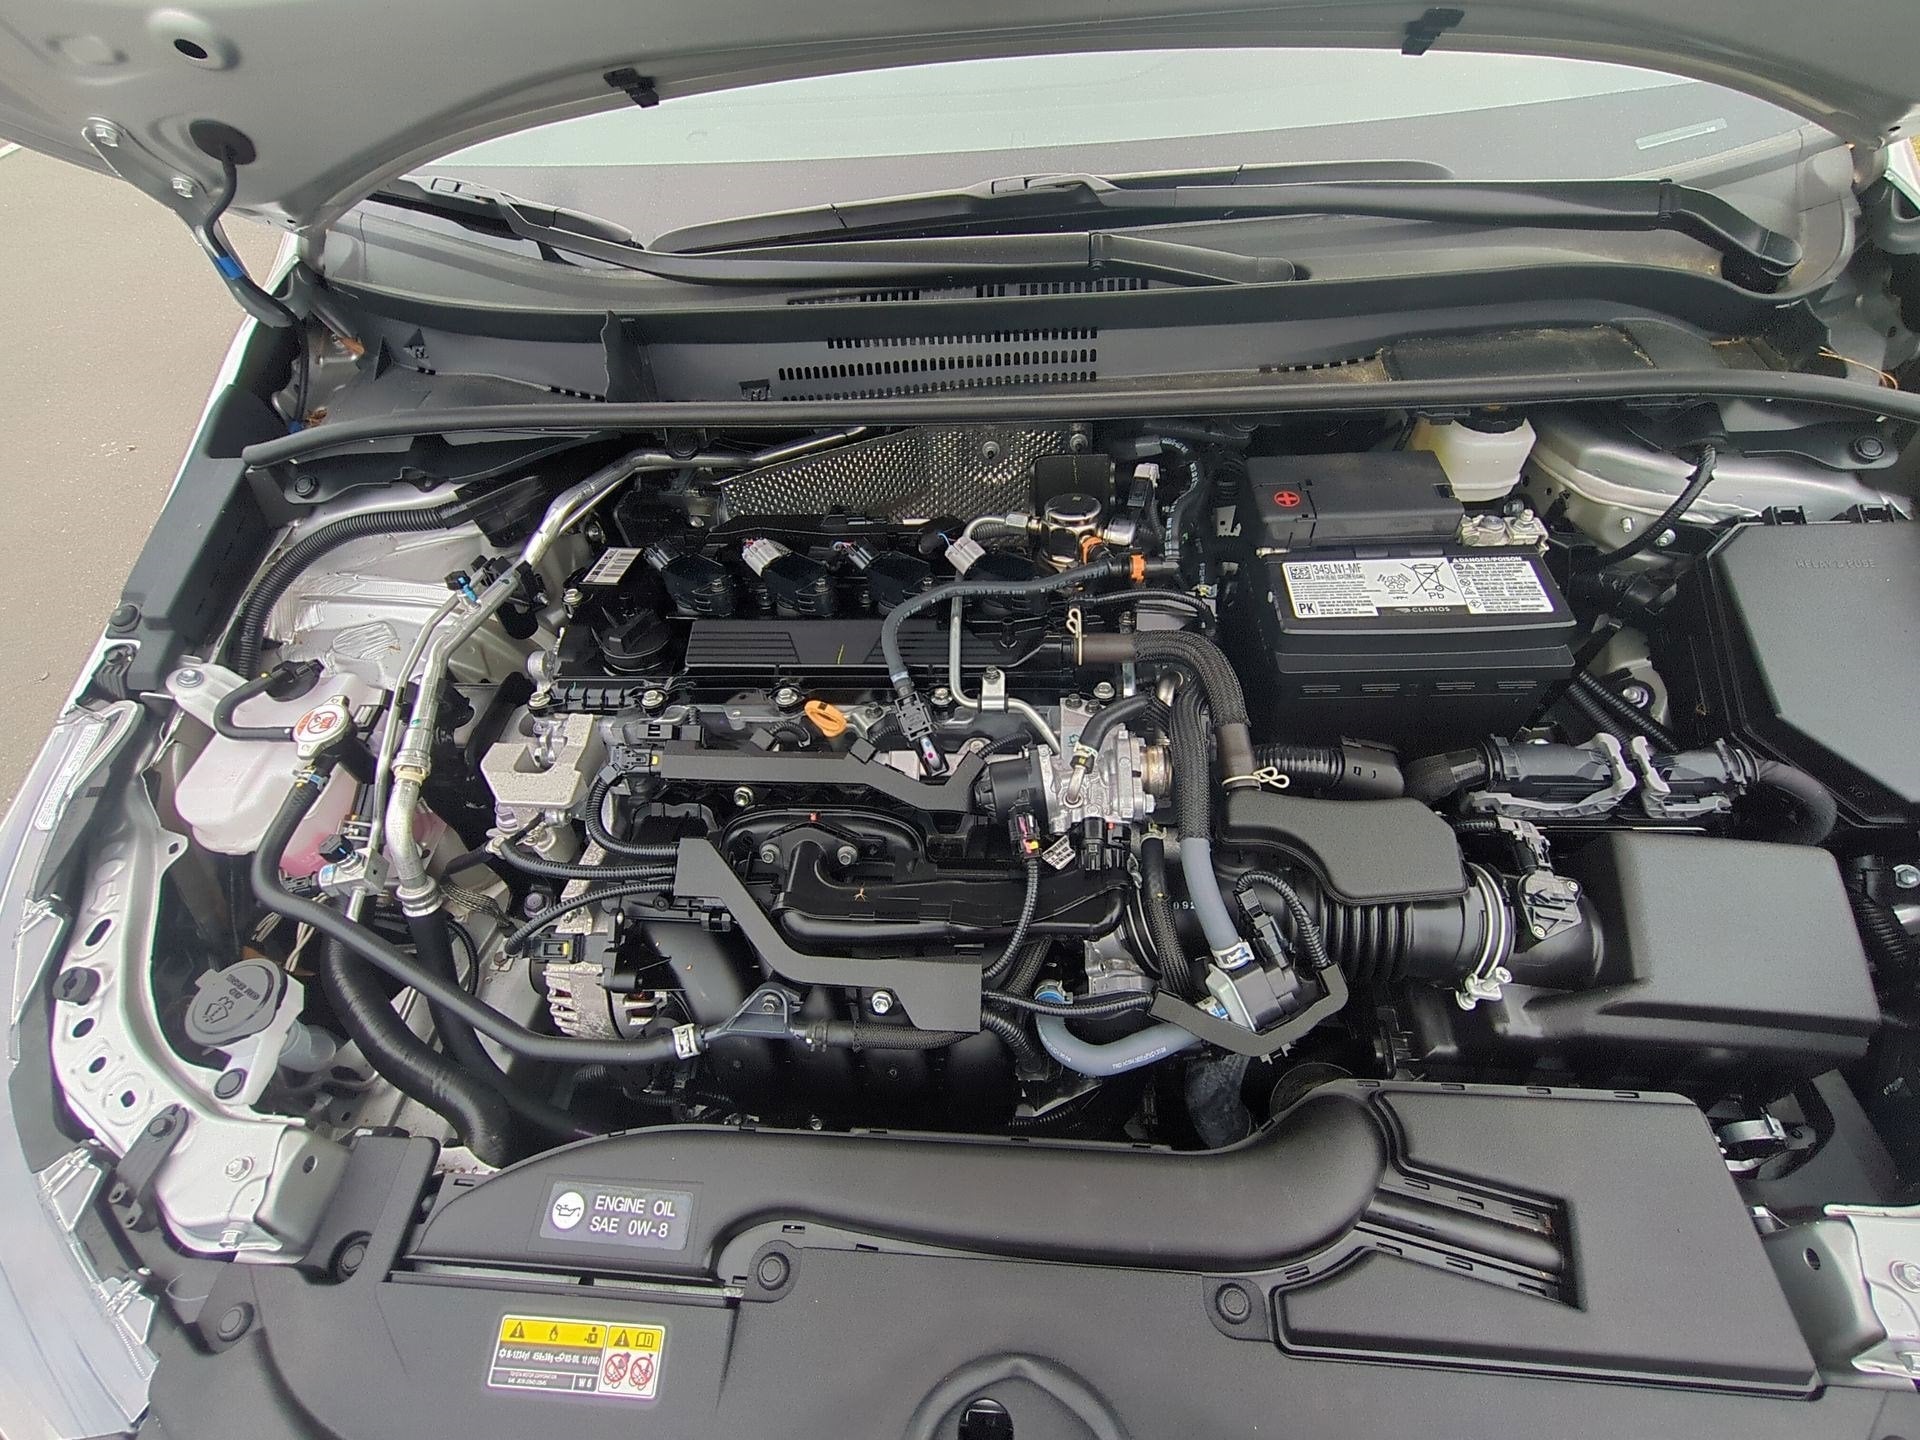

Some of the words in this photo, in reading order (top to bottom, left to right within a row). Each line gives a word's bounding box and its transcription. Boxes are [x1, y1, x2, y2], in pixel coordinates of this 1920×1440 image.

[1313, 563, 1362, 575] 345LN1-MF
[1428, 592, 1445, 600] Pb
[1299, 603, 1316, 614] PK
[594, 1195, 646, 1214] ENGINE
[653, 1200, 676, 1217] OIL
[589, 1216, 620, 1234] SAE
[628, 1219, 669, 1238] 0W-8
